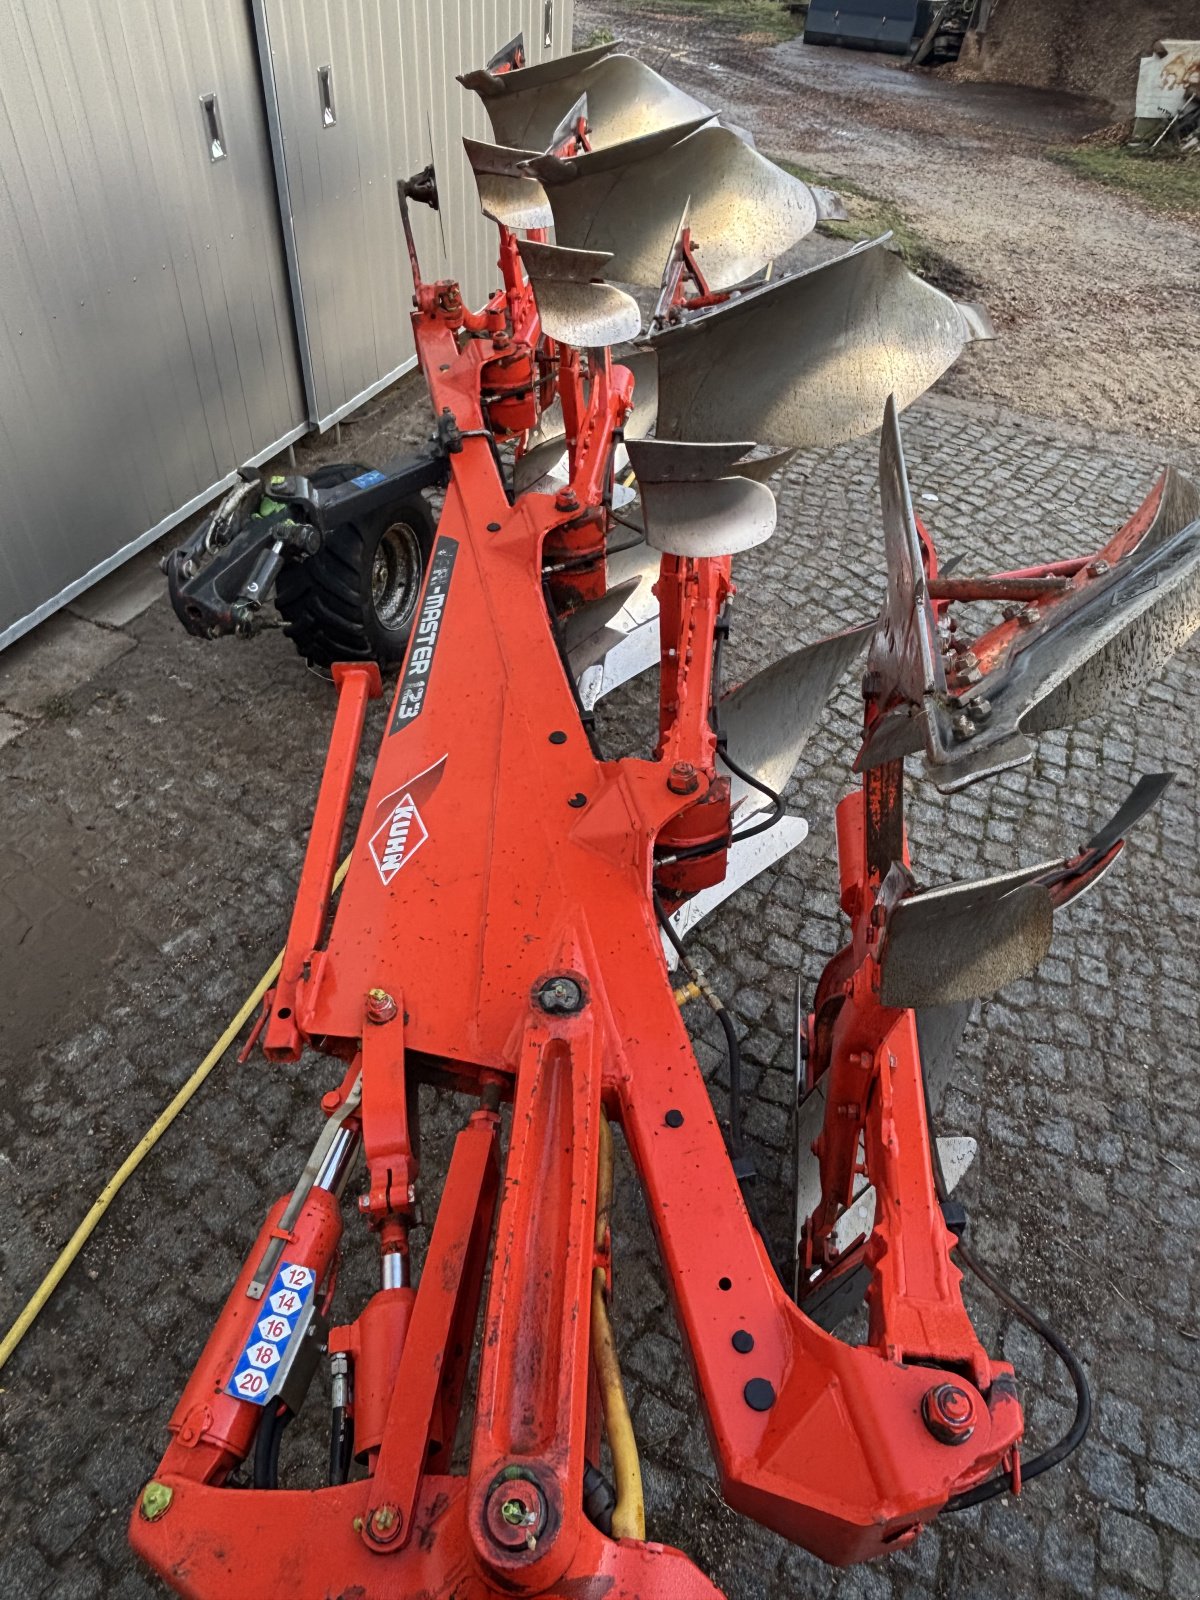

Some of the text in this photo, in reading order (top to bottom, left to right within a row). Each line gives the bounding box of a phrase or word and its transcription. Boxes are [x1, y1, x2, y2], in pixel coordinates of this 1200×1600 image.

[399, 549, 453, 719] RI-MASTER 123
[381, 805, 414, 872] KUHN
[289, 1269, 306, 1286] 12
[279, 1293, 294, 1311] 14
[267, 1319, 285, 1338] 16
[256, 1345, 273, 1364] 18
[239, 1373, 263, 1393] 20
